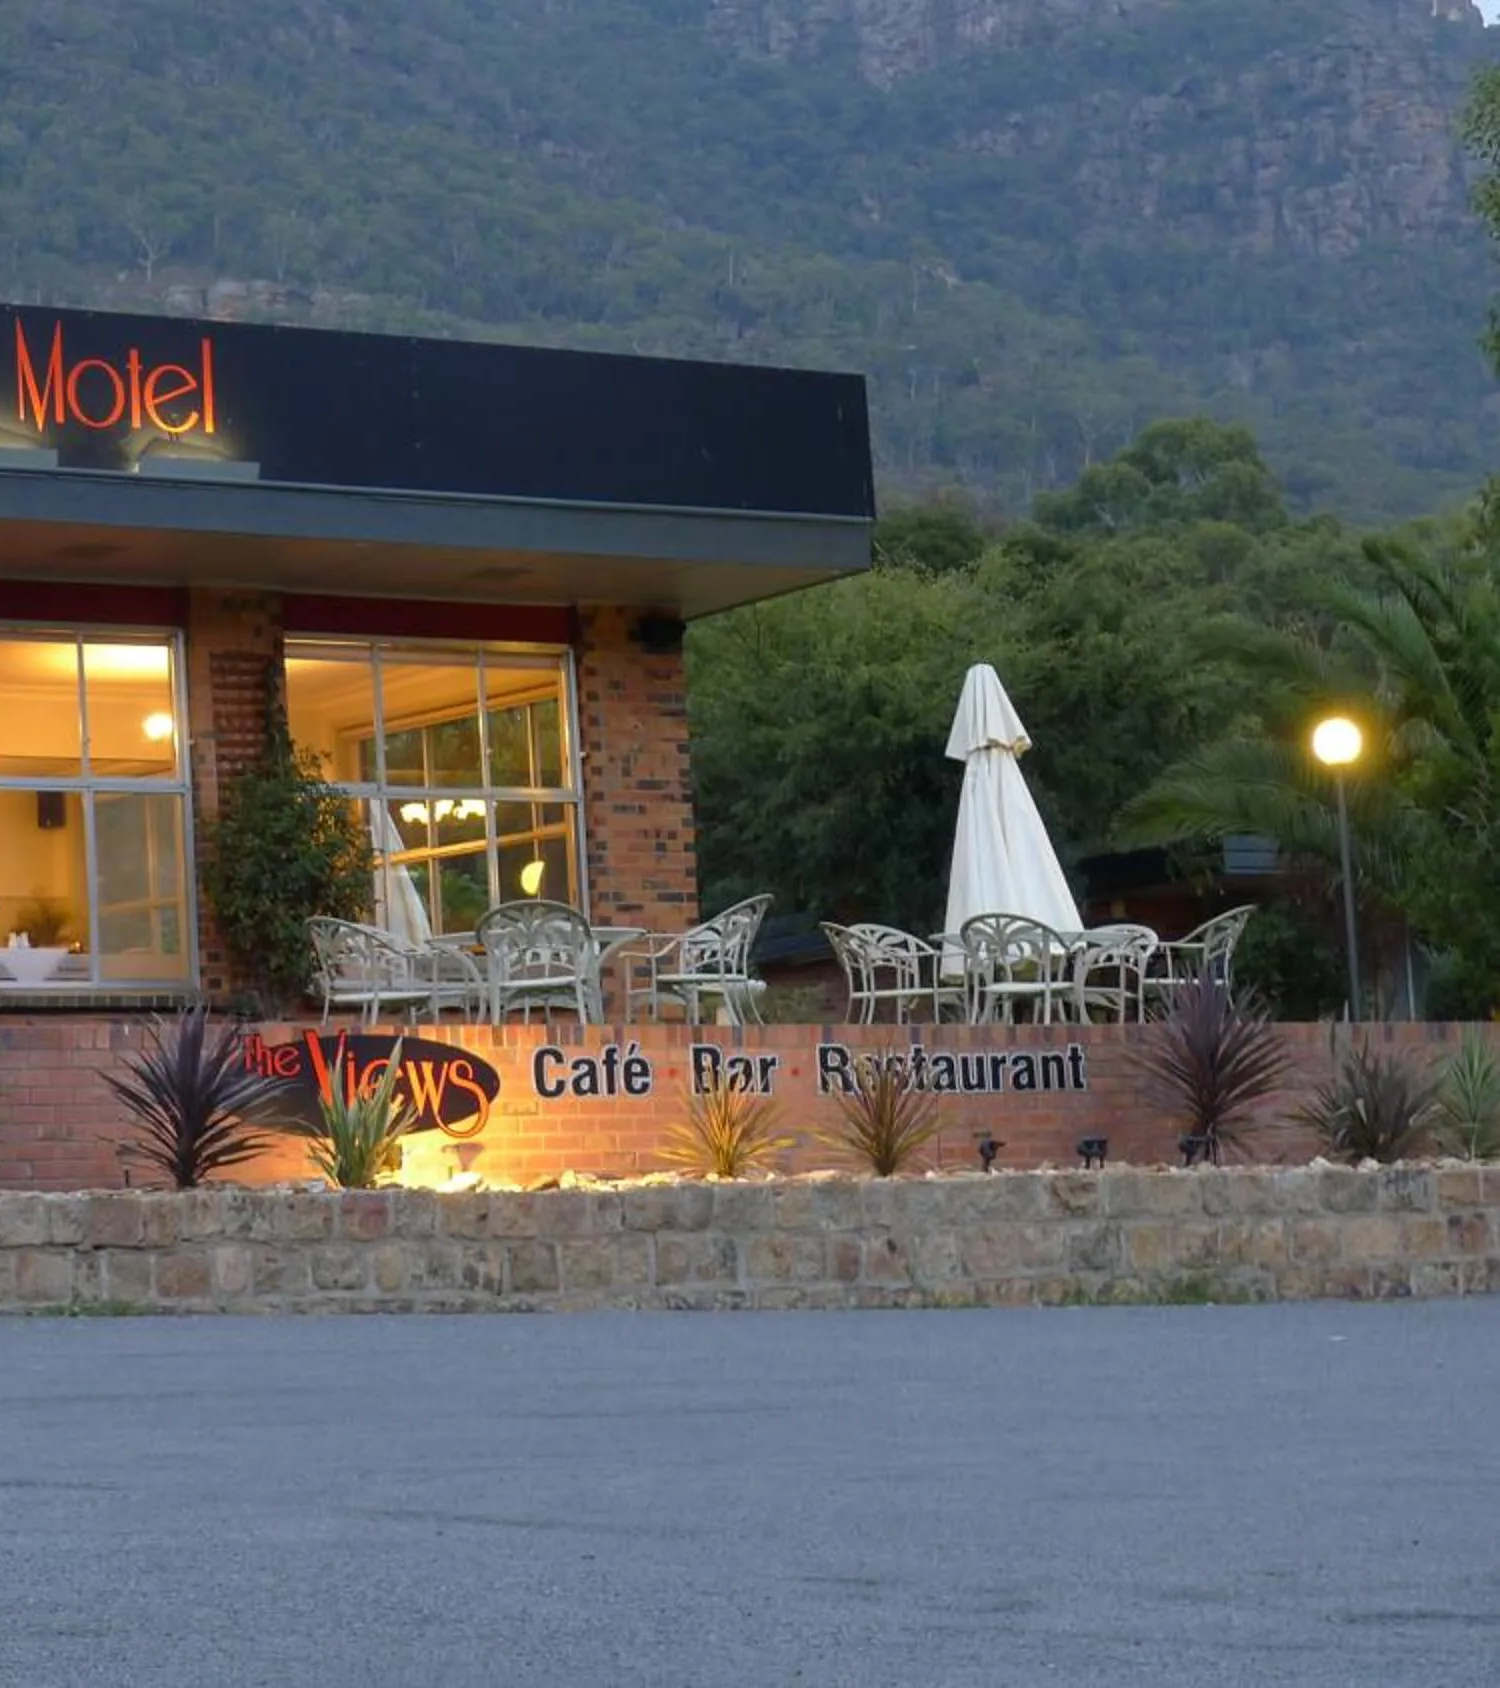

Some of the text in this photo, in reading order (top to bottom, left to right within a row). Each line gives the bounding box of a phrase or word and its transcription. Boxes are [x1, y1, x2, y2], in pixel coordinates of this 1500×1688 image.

[15, 316, 215, 434] Motel
[533, 1042, 1086, 1098] Café Bar Rtaurant
